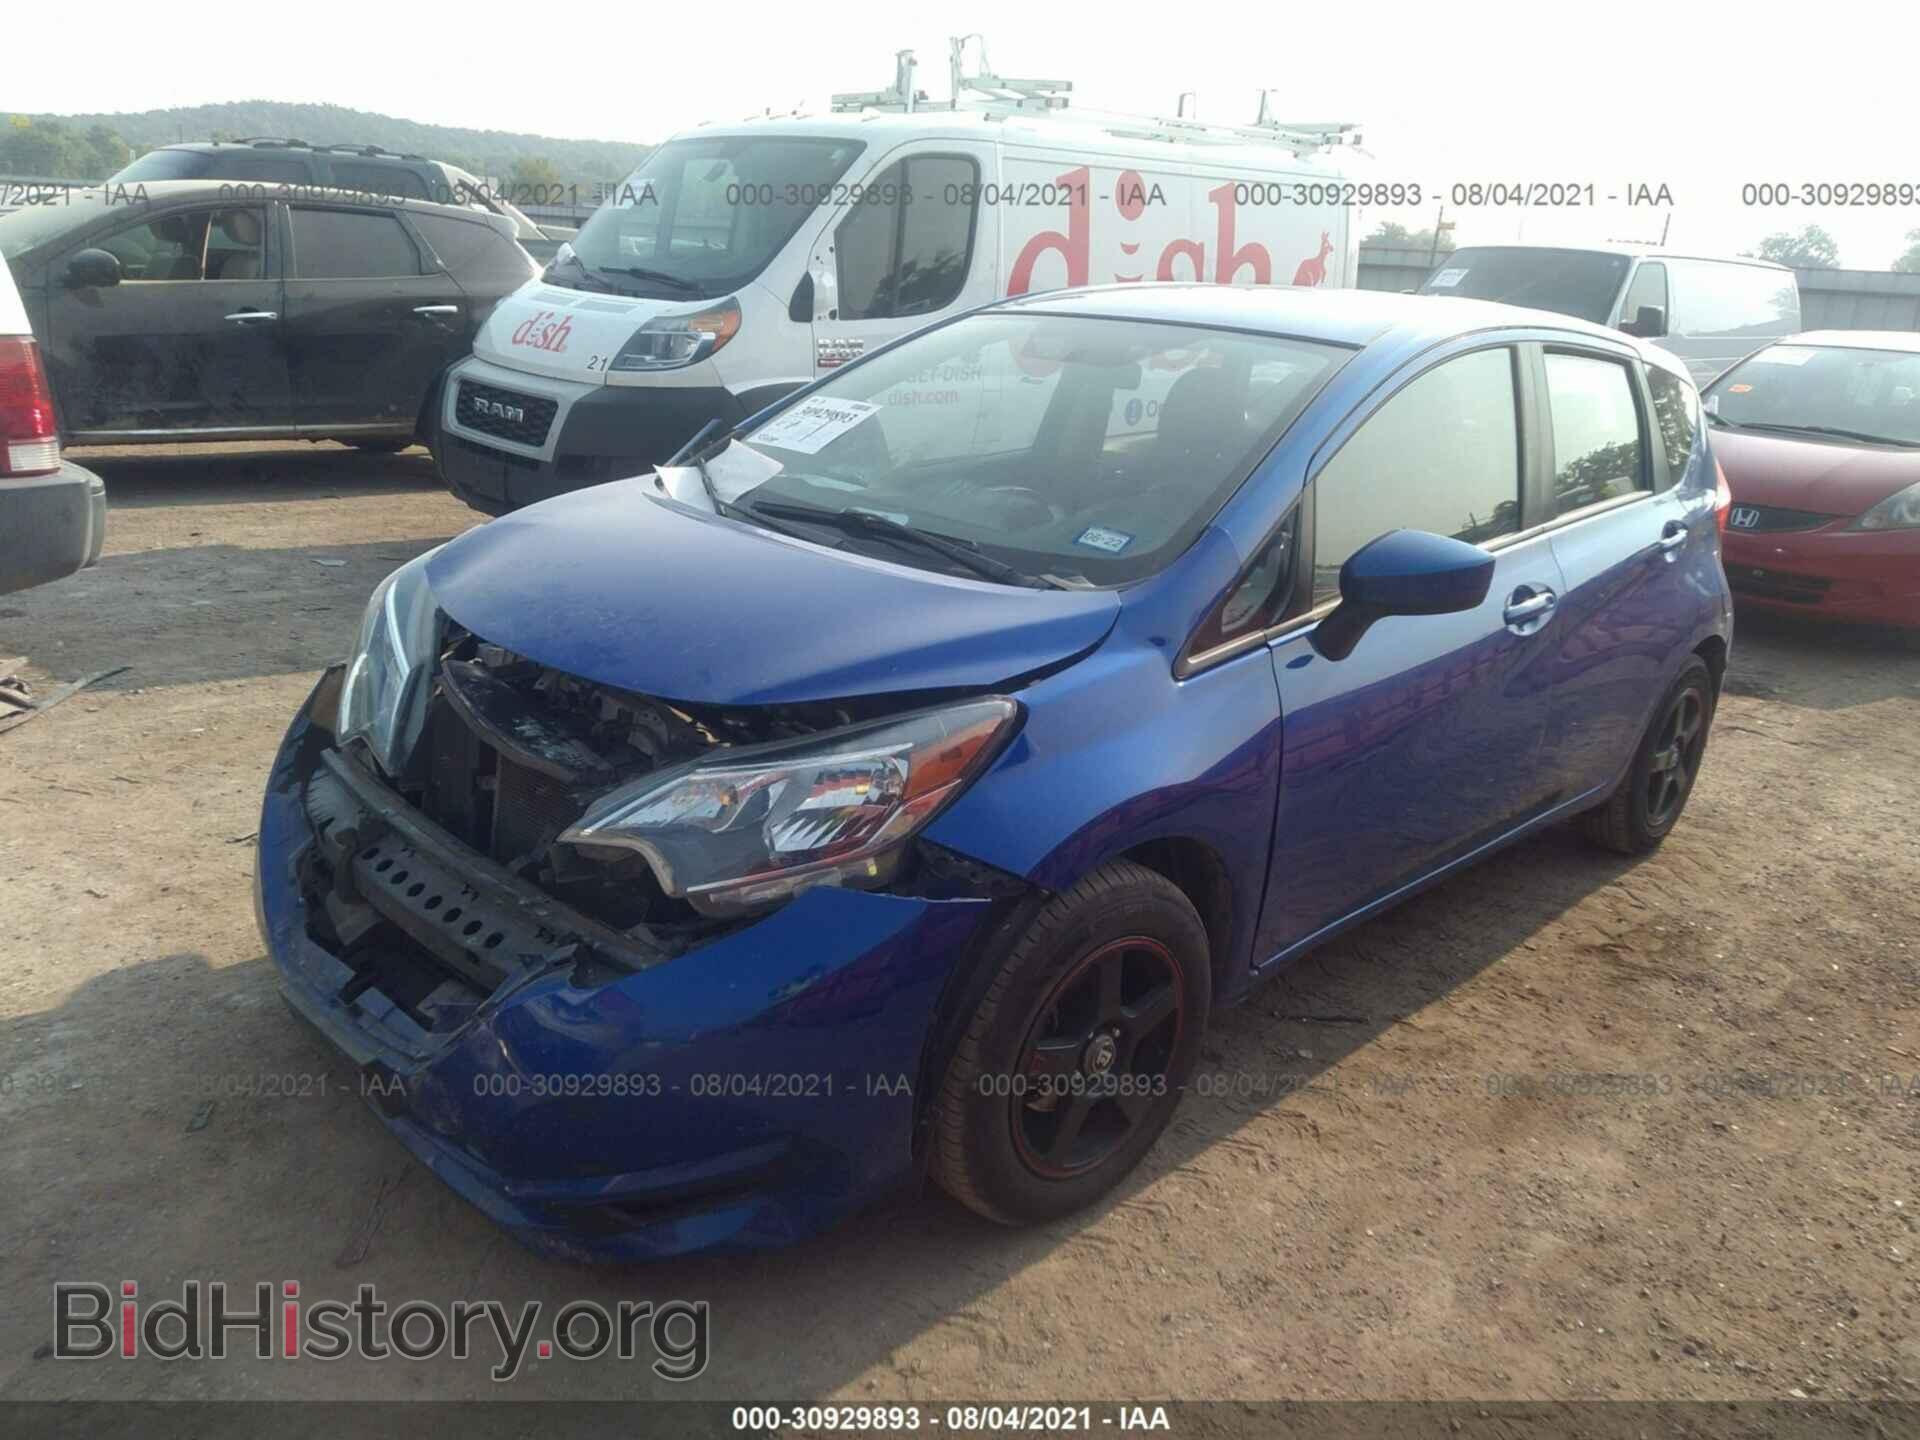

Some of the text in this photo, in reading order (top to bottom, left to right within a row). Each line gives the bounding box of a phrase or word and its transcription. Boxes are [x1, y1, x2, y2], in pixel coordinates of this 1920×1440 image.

[511, 311, 574, 353] dish
[587, 355, 608, 372] 21
[473, 396, 525, 423] RAM
